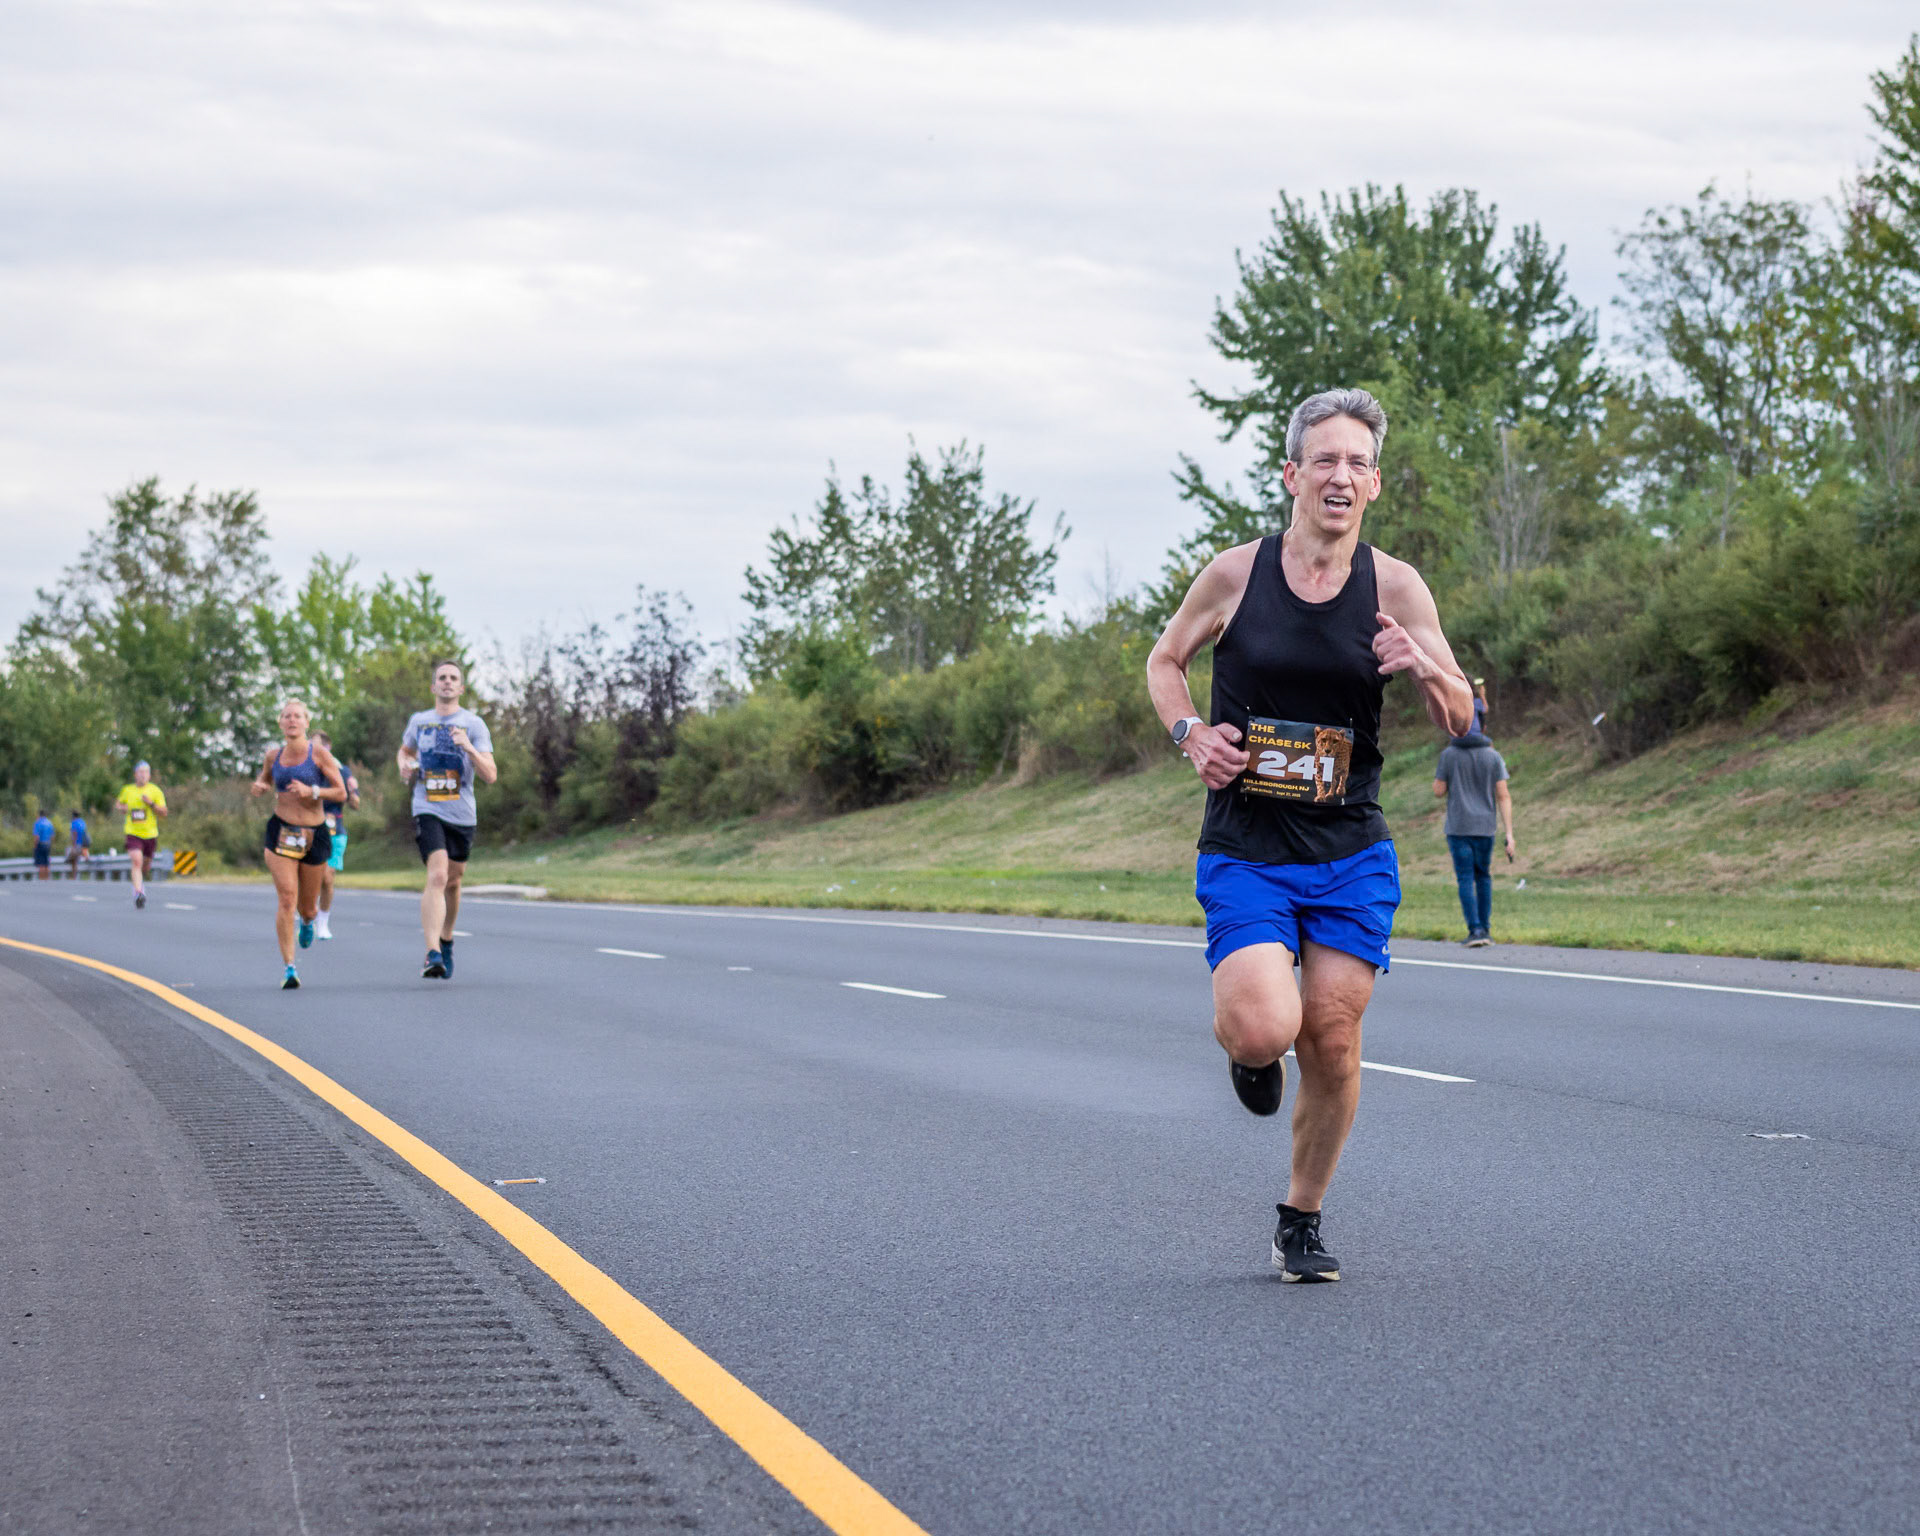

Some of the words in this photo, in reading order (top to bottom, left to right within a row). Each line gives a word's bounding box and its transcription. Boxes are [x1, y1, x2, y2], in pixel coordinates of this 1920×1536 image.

[1250, 723, 1276, 734] THE
[1248, 735, 1292, 748] CHASE
[1293, 741, 1312, 750] 5K
[1256, 750, 1335, 782] 241
